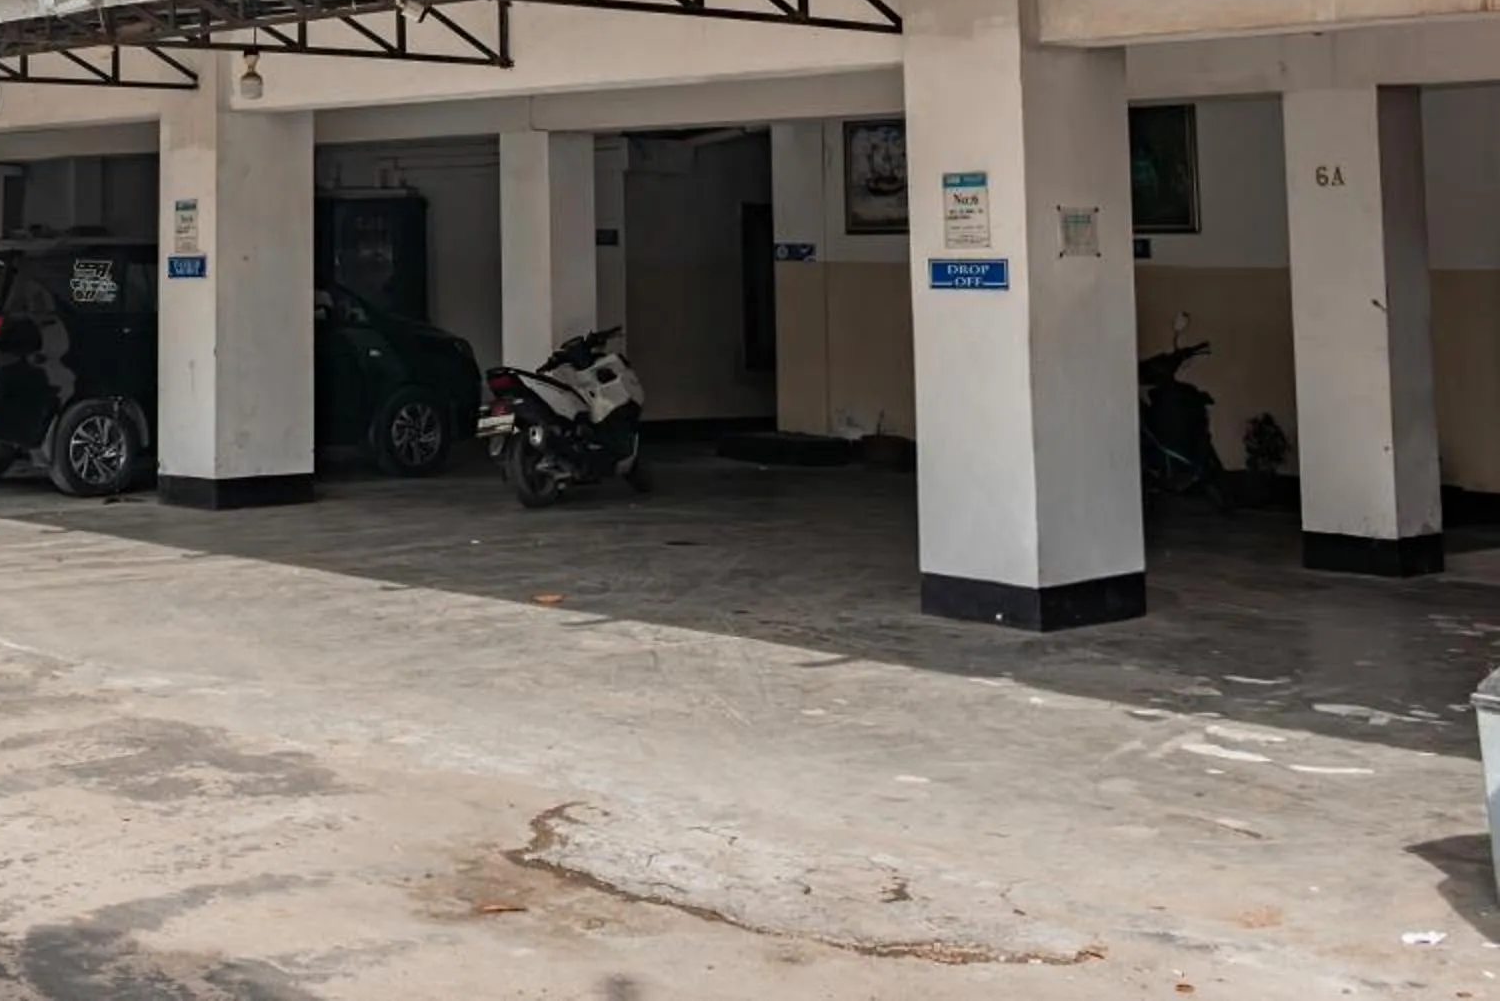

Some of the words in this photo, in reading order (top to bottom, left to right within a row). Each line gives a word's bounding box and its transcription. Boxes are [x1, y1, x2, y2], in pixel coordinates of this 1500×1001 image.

[1315, 166, 1347, 187] 6A
[947, 264, 991, 276] DROP
[954, 276, 982, 288] OFF
